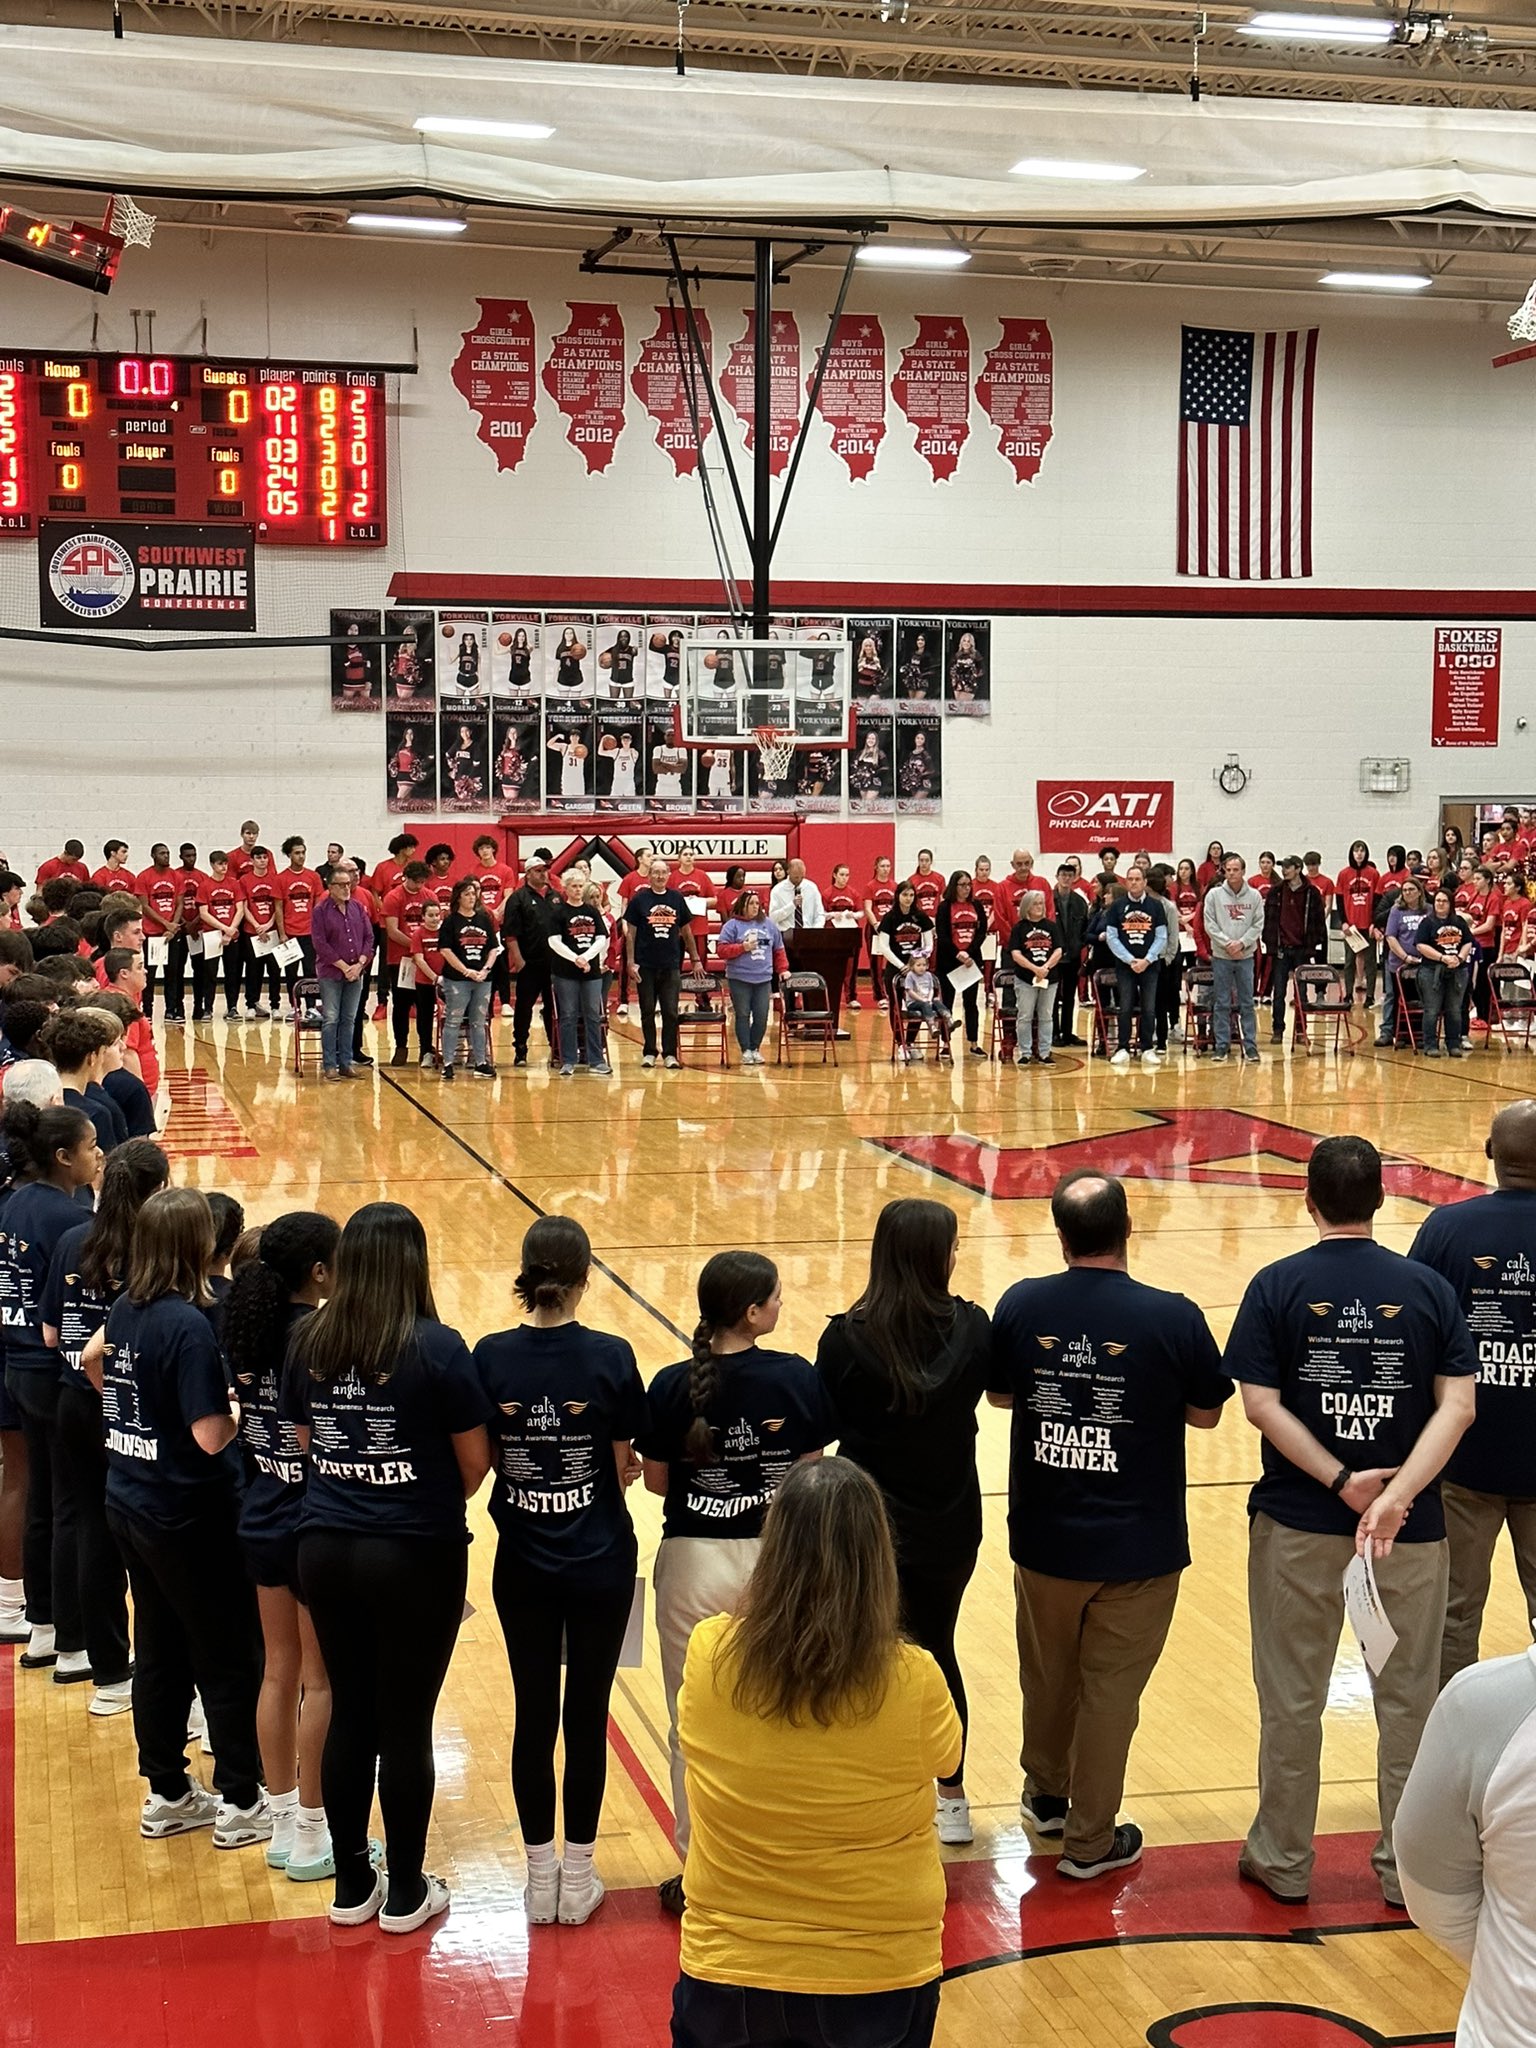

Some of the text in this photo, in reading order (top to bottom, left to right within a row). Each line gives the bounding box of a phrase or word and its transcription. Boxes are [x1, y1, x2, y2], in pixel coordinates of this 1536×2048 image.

[490, 328, 512, 336] GIRLS
[578, 328, 602, 337] GIRLS
[471, 336, 530, 346] CROSS COUNTRY
[556, 337, 624, 346] CROSS COUNTRY
[645, 340, 671, 349] CROSS
[926, 341, 948, 349] GIRLS
[1009, 343, 1032, 351] GIRLS
[481, 351, 519, 360] 2A STATE
[563, 348, 610, 358] 2A STATE
[652, 352, 665, 360] 2A
[741, 355, 754, 363] 2A
[846, 348, 884, 356] COUNTRY
[989, 351, 1051, 360] CROSS COUNTRY
[0, 359, 24, 372] ouls
[45, 361, 80, 378] Home
[471, 360, 529, 372] CHAMPIONS
[550, 359, 622, 371] CHAMPIONS
[826, 359, 871, 367] 2A STATE
[911, 360, 956, 369] 2A STATE
[995, 363, 1039, 371] 2A STATE
[119, 361, 169, 395] 0.0
[203, 368, 246, 384] Guests
[260, 368, 376, 386] player points fouls
[899, 370, 967, 382] CHAMPIONS
[983, 372, 1051, 384] CHAMPIONS
[0, 375, 15, 400] 2
[67, 383, 88, 417] 0
[171, 401, 179, 412] 4
[228, 390, 249, 423] 0
[265, 386, 366, 414] 02 8 2
[0, 402, 15, 427] 2
[125, 419, 166, 434] period
[275, 414, 367, 440] 11 2 3
[490, 421, 523, 438] 2011
[0, 428, 15, 453] 2
[575, 427, 613, 443] 2012
[51, 442, 80, 457] fouls
[126, 443, 166, 460] player
[266, 438, 367, 466] 03 3 0
[837, 439, 875, 454] 2014
[921, 440, 958, 455] 2014
[1005, 442, 1041, 457] 2015
[211, 448, 240, 462] fouls
[9, 457, 17, 478] 1
[62, 464, 78, 489] 0
[220, 470, 236, 494] 0
[267, 464, 367, 491] 24 0 1
[2, 481, 17, 507] 3
[267, 490, 367, 517] 05 2 2
[329, 519, 336, 541] 1
[61, 545, 123, 576] SPC
[138, 546, 246, 566] SOUTHWEST
[139, 567, 248, 597] PRAIRIE
[143, 599, 246, 610] CONFERENCE
[495, 613, 539, 621] YORKVILLE
[1438, 630, 1498, 643] FOXES
[1438, 643, 1498, 653] BASKETBALL
[1434, 737, 1445, 745] Y
[569, 758, 578, 767] 31
[622, 762, 627, 771] 5
[717, 758, 727, 768] 35
[1085, 793, 1162, 817] ATI
[1049, 819, 1155, 829] PHYSICAL THERAPY
[650, 840, 768, 855] YORKVILLE
[1501, 1269, 1535, 1285] angels
[1342, 1299, 1366, 1316] cal's
[1337, 1315, 1373, 1333] angels
[1068, 1334, 1092, 1352] cal's
[1307, 1336, 1332, 1344] Wishes
[1374, 1337, 1404, 1346] Research
[1062, 1351, 1097, 1368] angels
[1058, 1370, 1092, 1379] Awareness
[1096, 1373, 1126, 1383] Research
[332, 1380, 366, 1400] angels
[366, 1404, 395, 1412] Research
[531, 1396, 555, 1414] cal's
[1321, 1392, 1394, 1418] COACH
[527, 1412, 561, 1431] angels
[728, 1417, 752, 1435] cal's
[1335, 1415, 1380, 1441] LAY
[724, 1432, 760, 1451] angels
[1041, 1421, 1111, 1449] COACH
[761, 1449, 791, 1457] Research
[1033, 1440, 1119, 1473] KEINER
[311, 1453, 418, 1485] WHEELER
[506, 1482, 595, 1514] PASTORE
